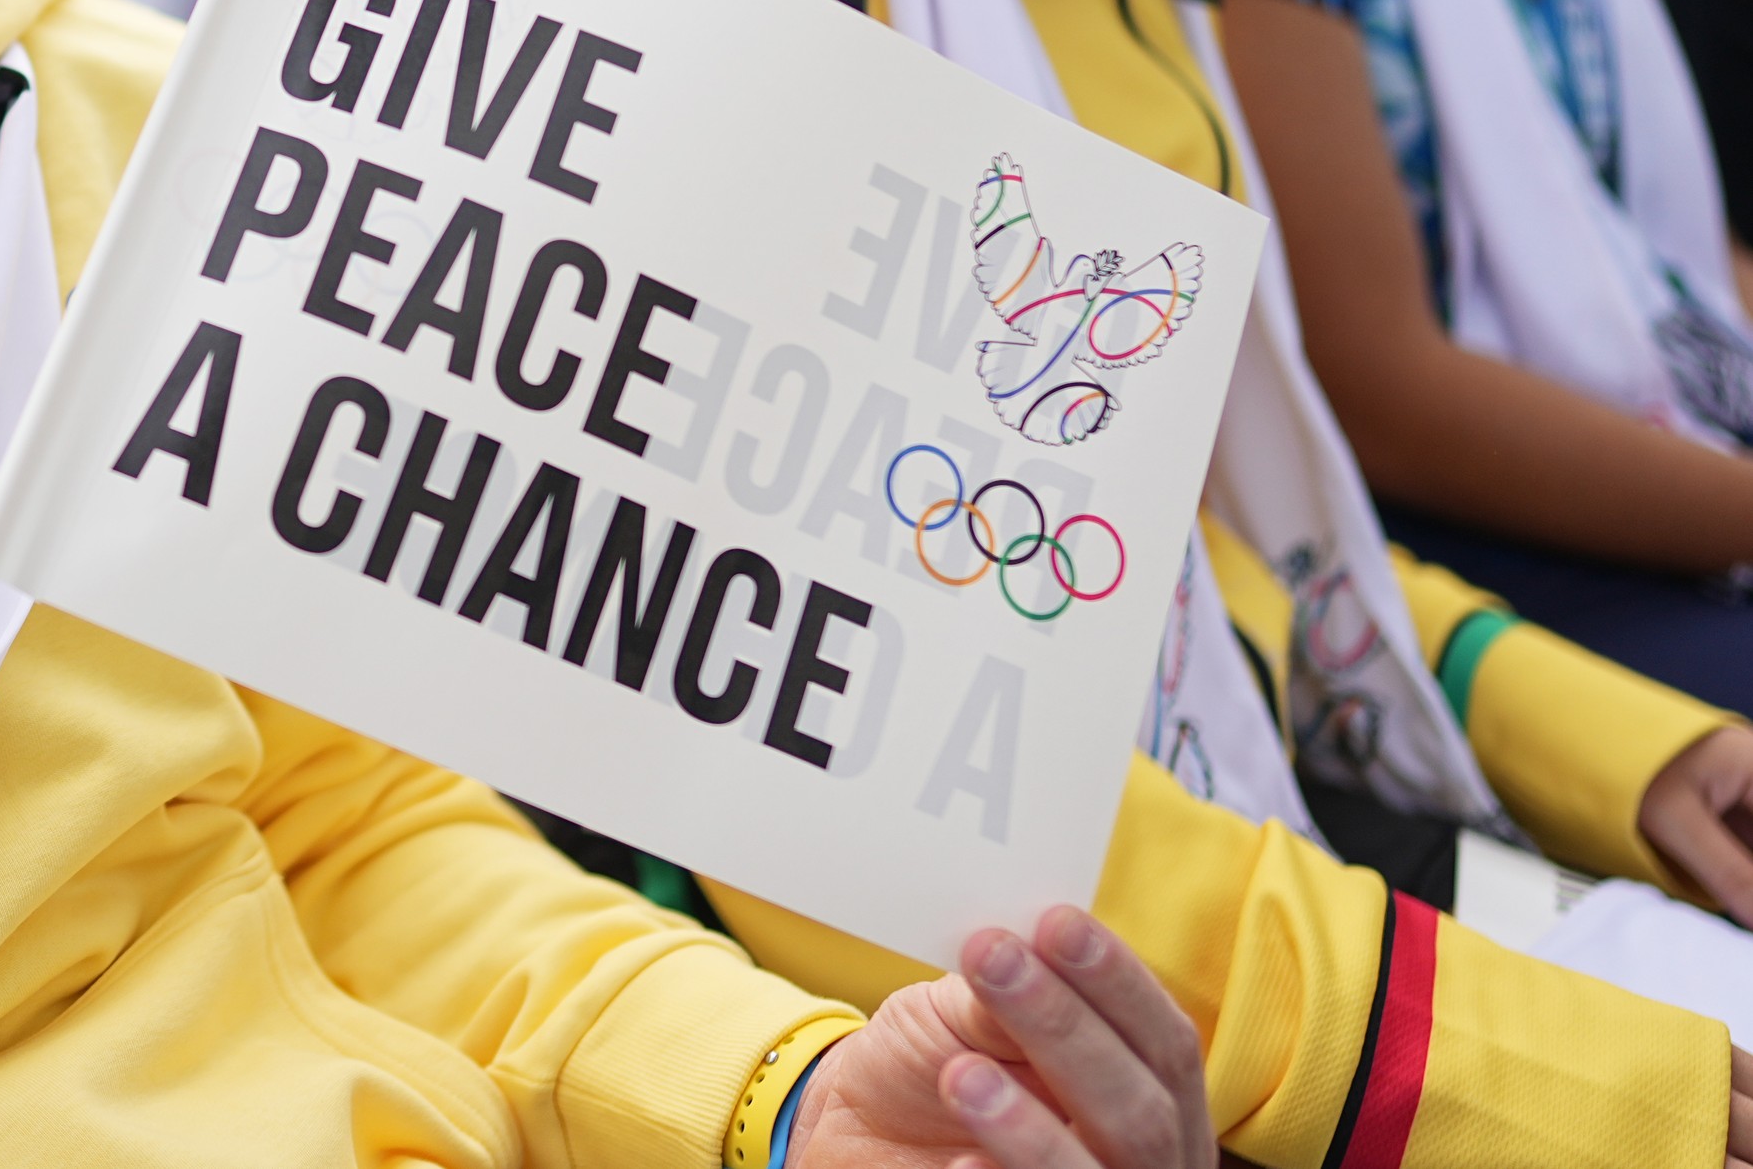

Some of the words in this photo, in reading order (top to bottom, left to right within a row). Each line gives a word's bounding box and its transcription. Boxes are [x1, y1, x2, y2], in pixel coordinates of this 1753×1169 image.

[200, 125, 699, 459] PEACE
[111, 320, 243, 508] A
[269, 375, 874, 772] CHANCE
